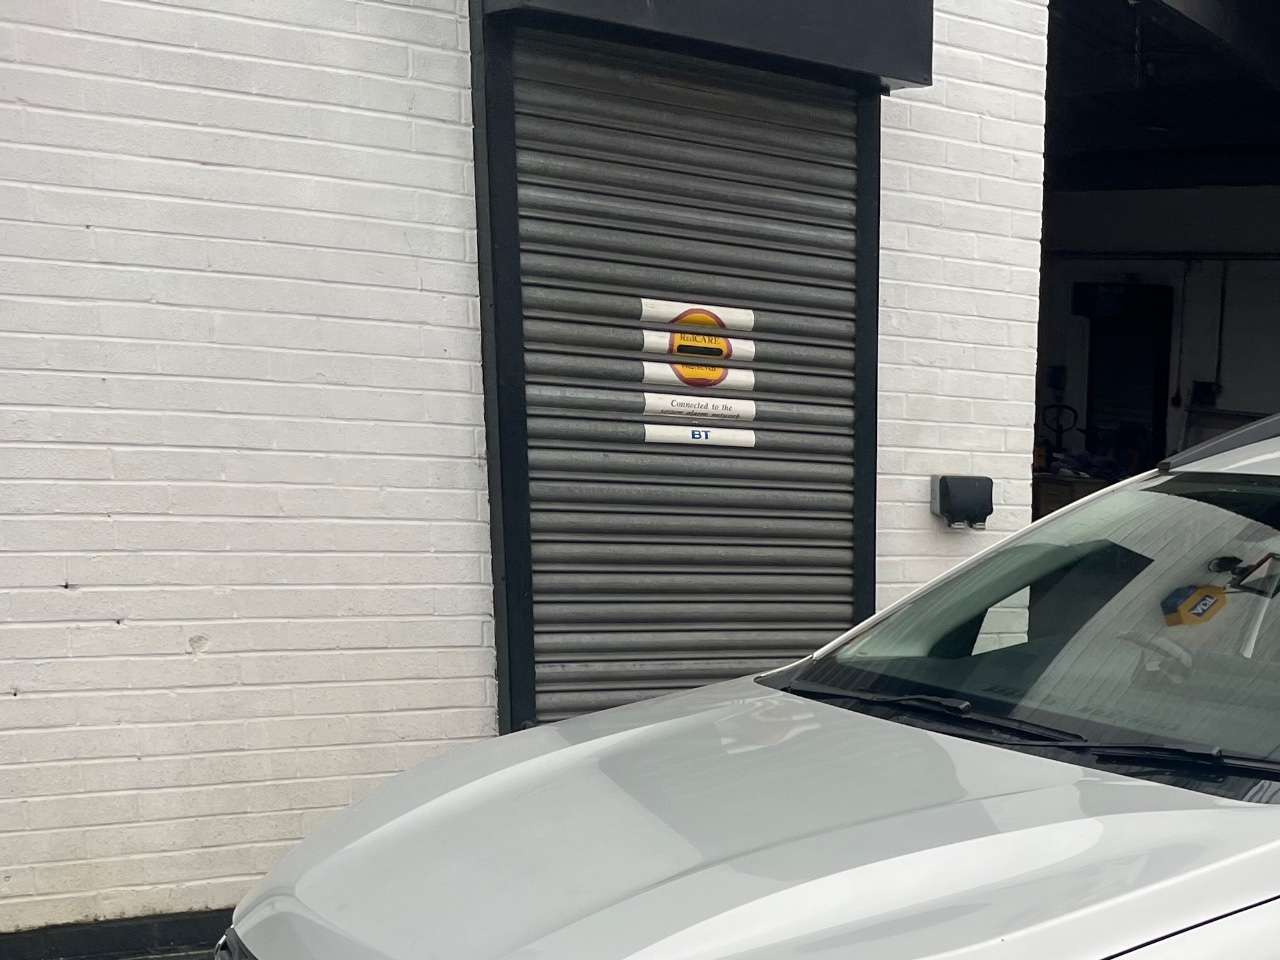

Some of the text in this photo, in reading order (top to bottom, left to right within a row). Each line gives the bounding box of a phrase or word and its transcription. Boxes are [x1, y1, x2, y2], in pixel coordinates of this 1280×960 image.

[671, 399, 709, 410] Connected
[712, 403, 719, 411] to
[691, 429, 711, 440] BT
